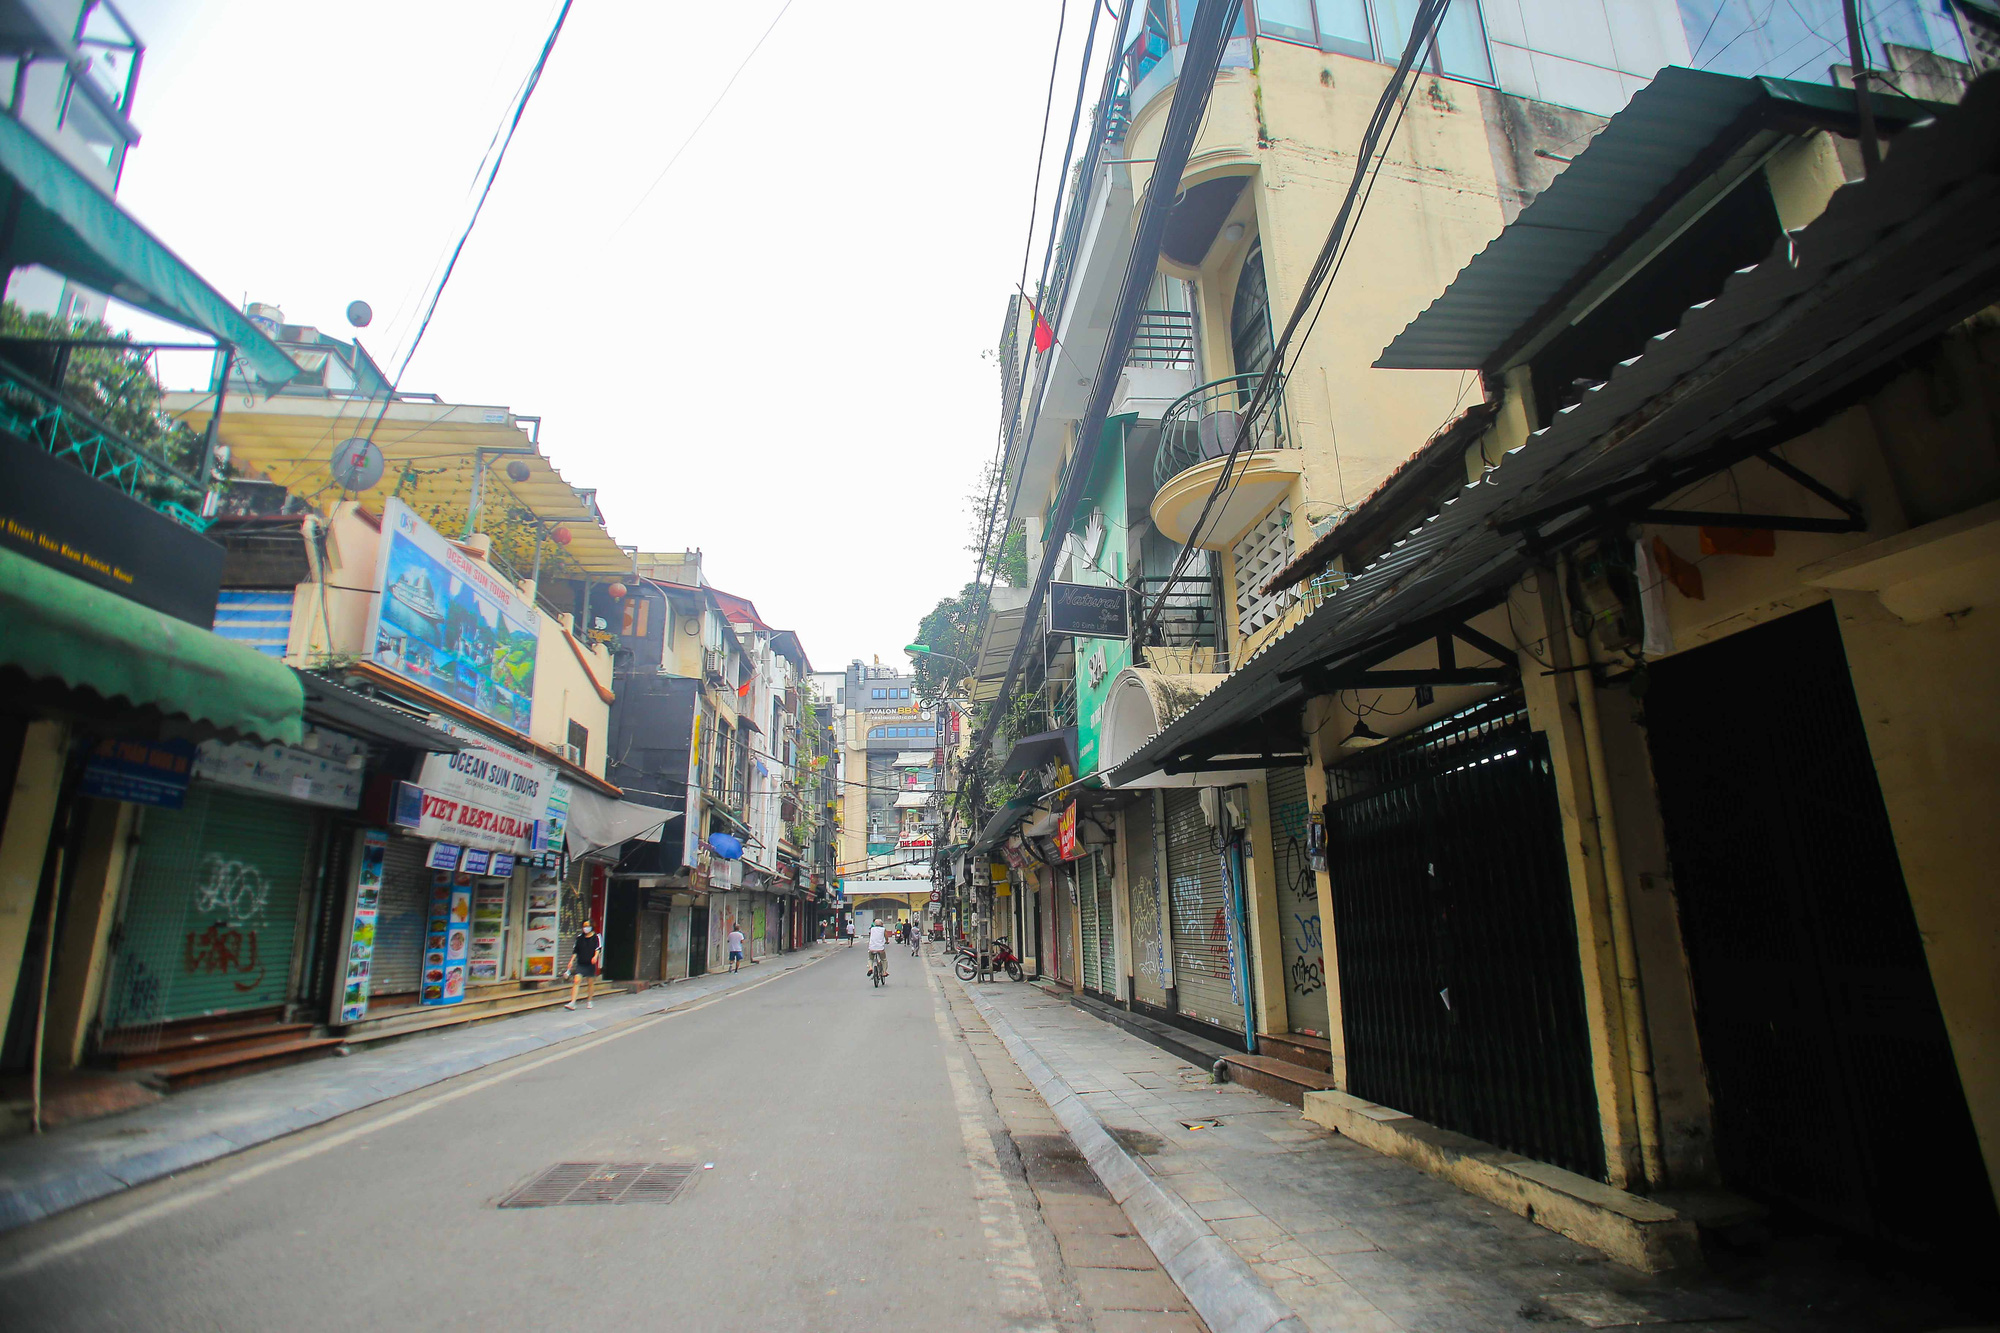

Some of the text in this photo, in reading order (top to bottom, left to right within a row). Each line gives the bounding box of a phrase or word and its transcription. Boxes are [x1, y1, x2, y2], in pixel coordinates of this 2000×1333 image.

[446, 547, 472, 575] OCEAN
[472, 569, 488, 588] SUN
[489, 581, 510, 605] TOURS
[1058, 588, 1121, 623] Natural Spa
[1088, 645, 1108, 689] SPA
[448, 751, 489, 780] OCEAN
[488, 764, 511, 788] SUN
[511, 773, 539, 798] TOURS
[422, 795, 458, 821] VIET
[458, 805, 533, 840] RESTAURAN
